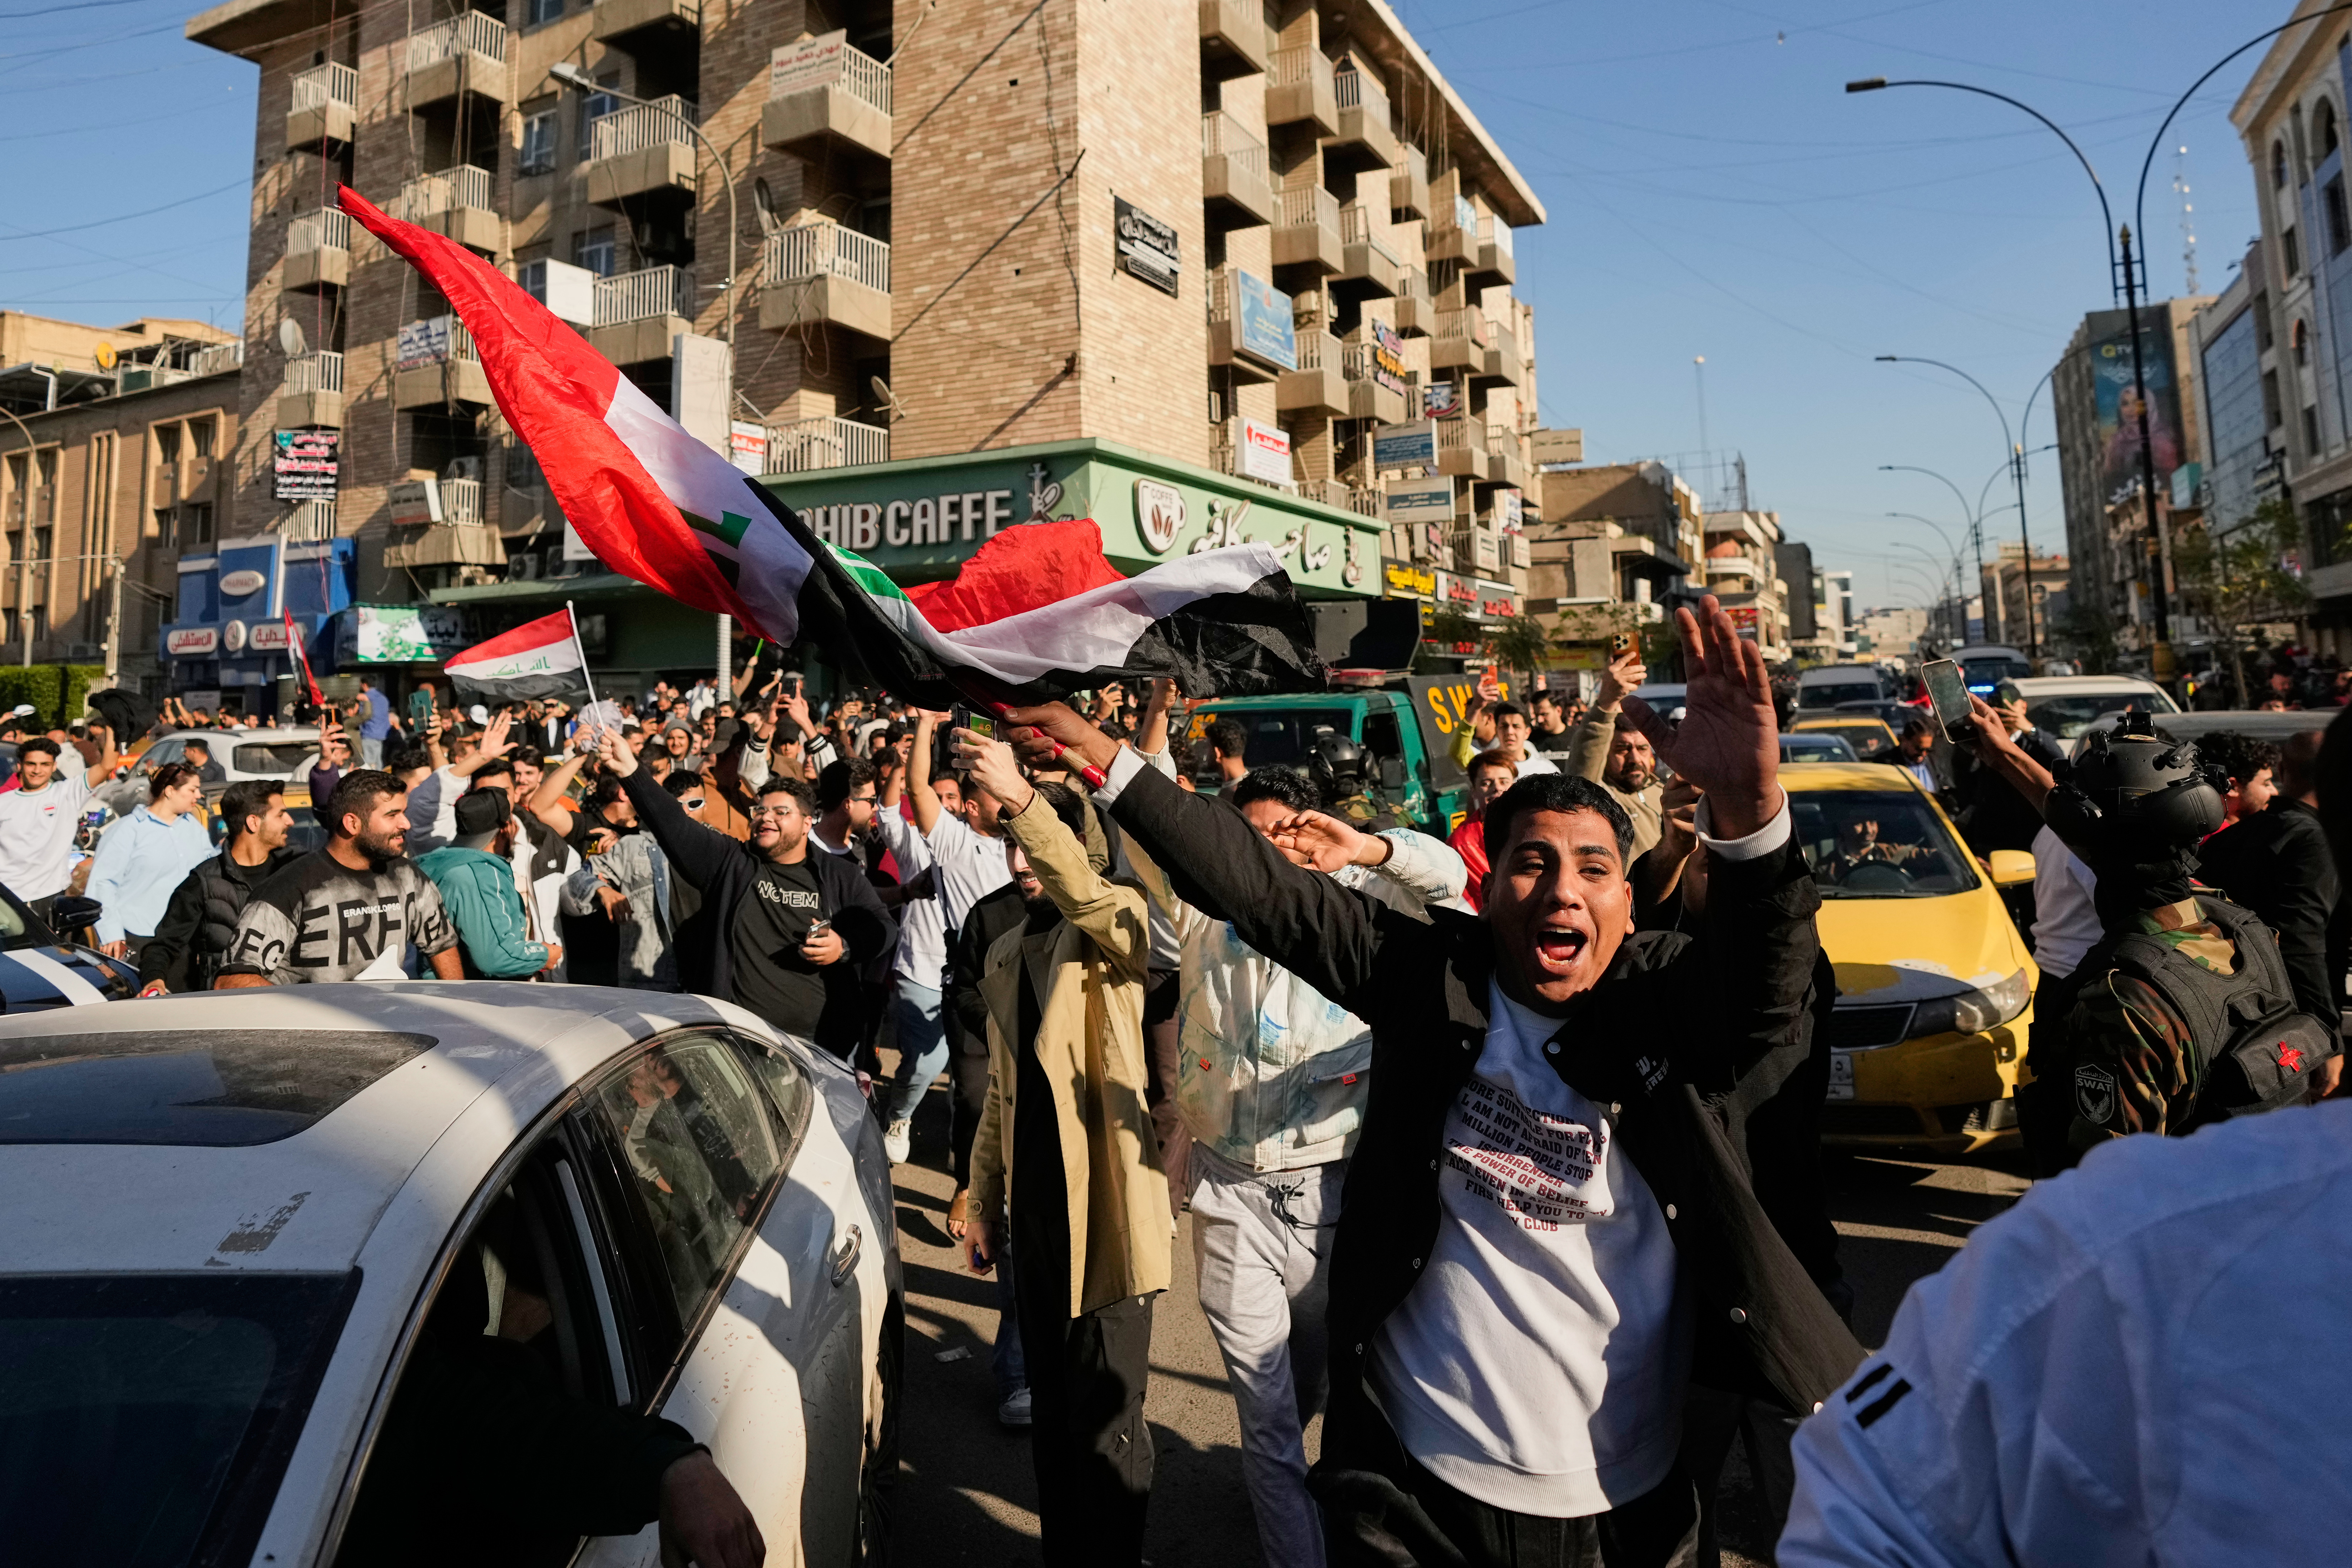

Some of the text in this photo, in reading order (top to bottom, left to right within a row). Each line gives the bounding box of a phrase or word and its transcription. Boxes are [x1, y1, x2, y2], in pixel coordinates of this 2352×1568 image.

[886, 490, 1012, 547] CAFFE
[256, 628, 290, 647] يدلية
[2077, 1078, 2112, 1092] SWAT
[2078, 1069, 2098, 1078] الداخلية
[1471, 1100, 1494, 1119] AM
[1493, 1111, 1520, 1134] NOT
[1520, 1127, 1562, 1155] AFRAID
[1566, 1145, 1581, 1160] OF
[1546, 1128, 1575, 1142] FOR
[1461, 1112, 1593, 1181] MILLION PEOPLE STOP
[1448, 1138, 1474, 1154] THE
[1472, 1152, 1517, 1179] POWER
[1517, 1173, 1536, 1188] OF
[1537, 1183, 1588, 1208] BELIEF
[1476, 1140, 1565, 1188] ISSURRENDER
[1475, 1166, 1507, 1193] EVEN
[1509, 1186, 1525, 1197] IN
[1496, 1196, 1531, 1213] HELP
[1536, 1204, 1562, 1216] YOU
[1567, 1210, 1585, 1220] TO
[1524, 1217, 1558, 1232] CLUB
